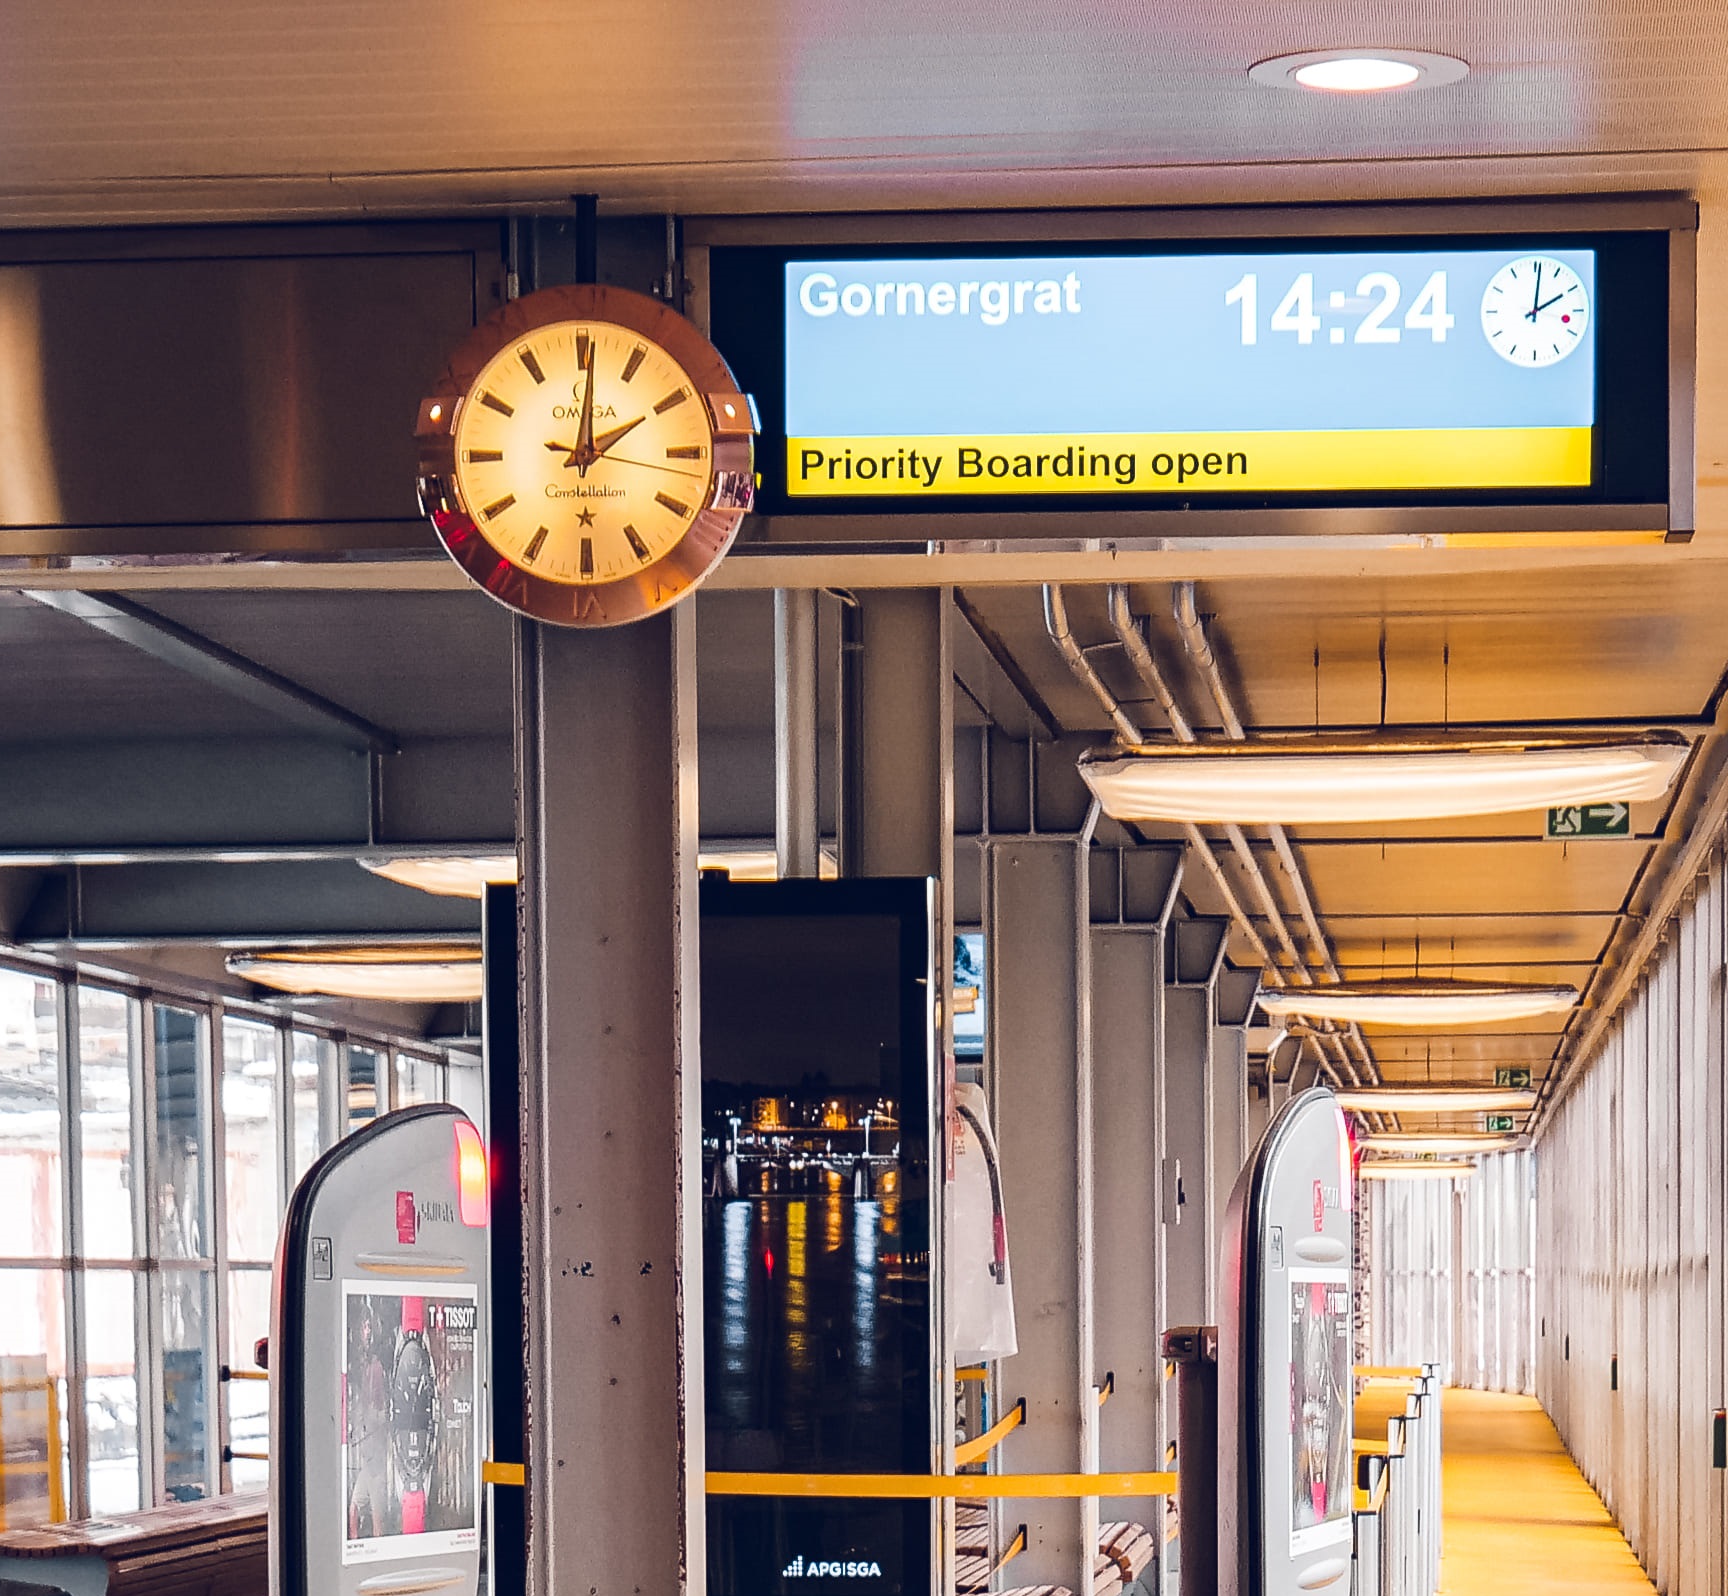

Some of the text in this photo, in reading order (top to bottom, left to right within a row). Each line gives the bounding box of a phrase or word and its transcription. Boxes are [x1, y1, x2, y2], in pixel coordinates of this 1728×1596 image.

[798, 269, 1455, 346] Gornergrat 14:24
[552, 404, 617, 419] OMGA
[799, 445, 1249, 487] Priority Boarding open
[545, 484, 626, 498] Constellation
[443, 1306, 475, 1329] TISSOT
